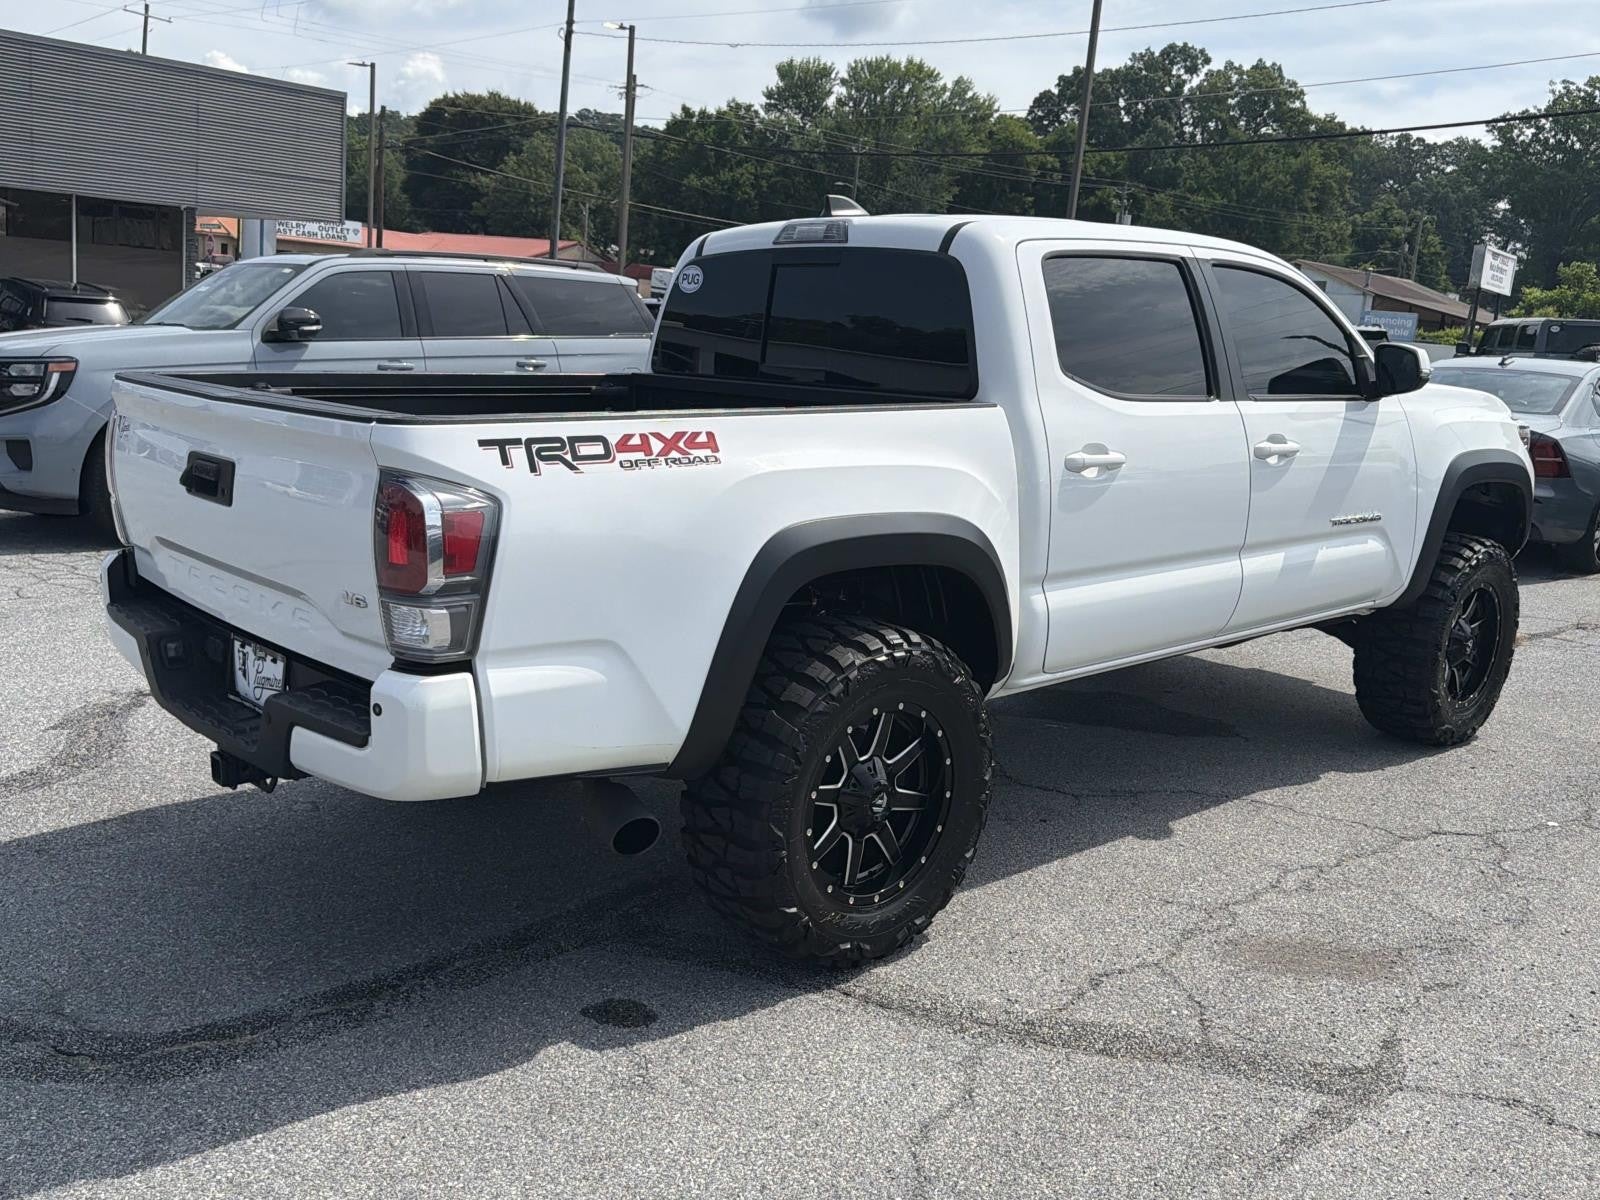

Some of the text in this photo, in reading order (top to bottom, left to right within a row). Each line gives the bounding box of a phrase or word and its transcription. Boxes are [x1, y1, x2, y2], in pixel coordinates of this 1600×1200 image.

[295, 229, 318, 238] CASH
[320, 232, 348, 242] LOANS
[318, 225, 350, 235] OUTLET
[682, 273, 700, 285] PUG
[1364, 315, 1413, 327] Financing
[478, 435, 616, 476] TRD
[619, 454, 722, 471] OFF ROAD
